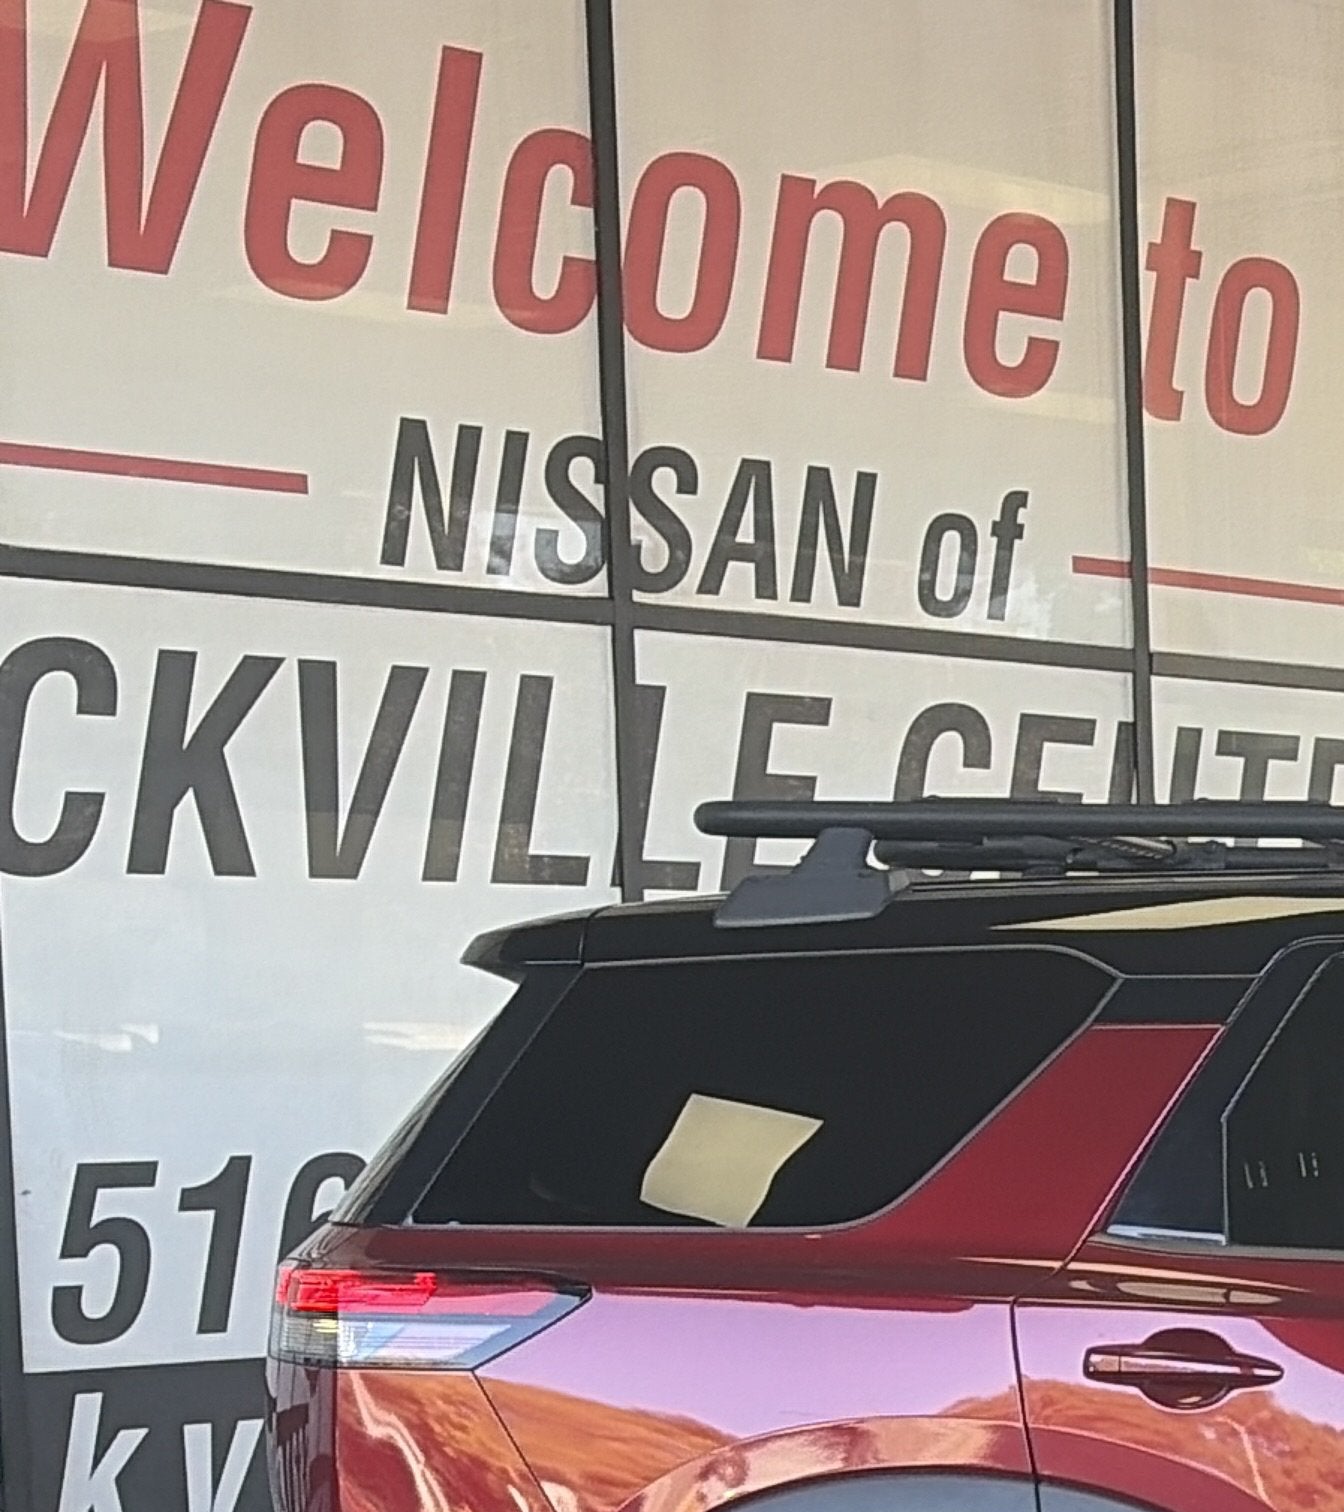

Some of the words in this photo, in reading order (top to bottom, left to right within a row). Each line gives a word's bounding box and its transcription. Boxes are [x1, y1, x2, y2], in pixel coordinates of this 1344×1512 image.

[0, 0, 1070, 400] Welcome
[1142, 197, 1301, 436] to
[379, 417, 878, 609] NISSAN
[916, 490, 1029, 621] of
